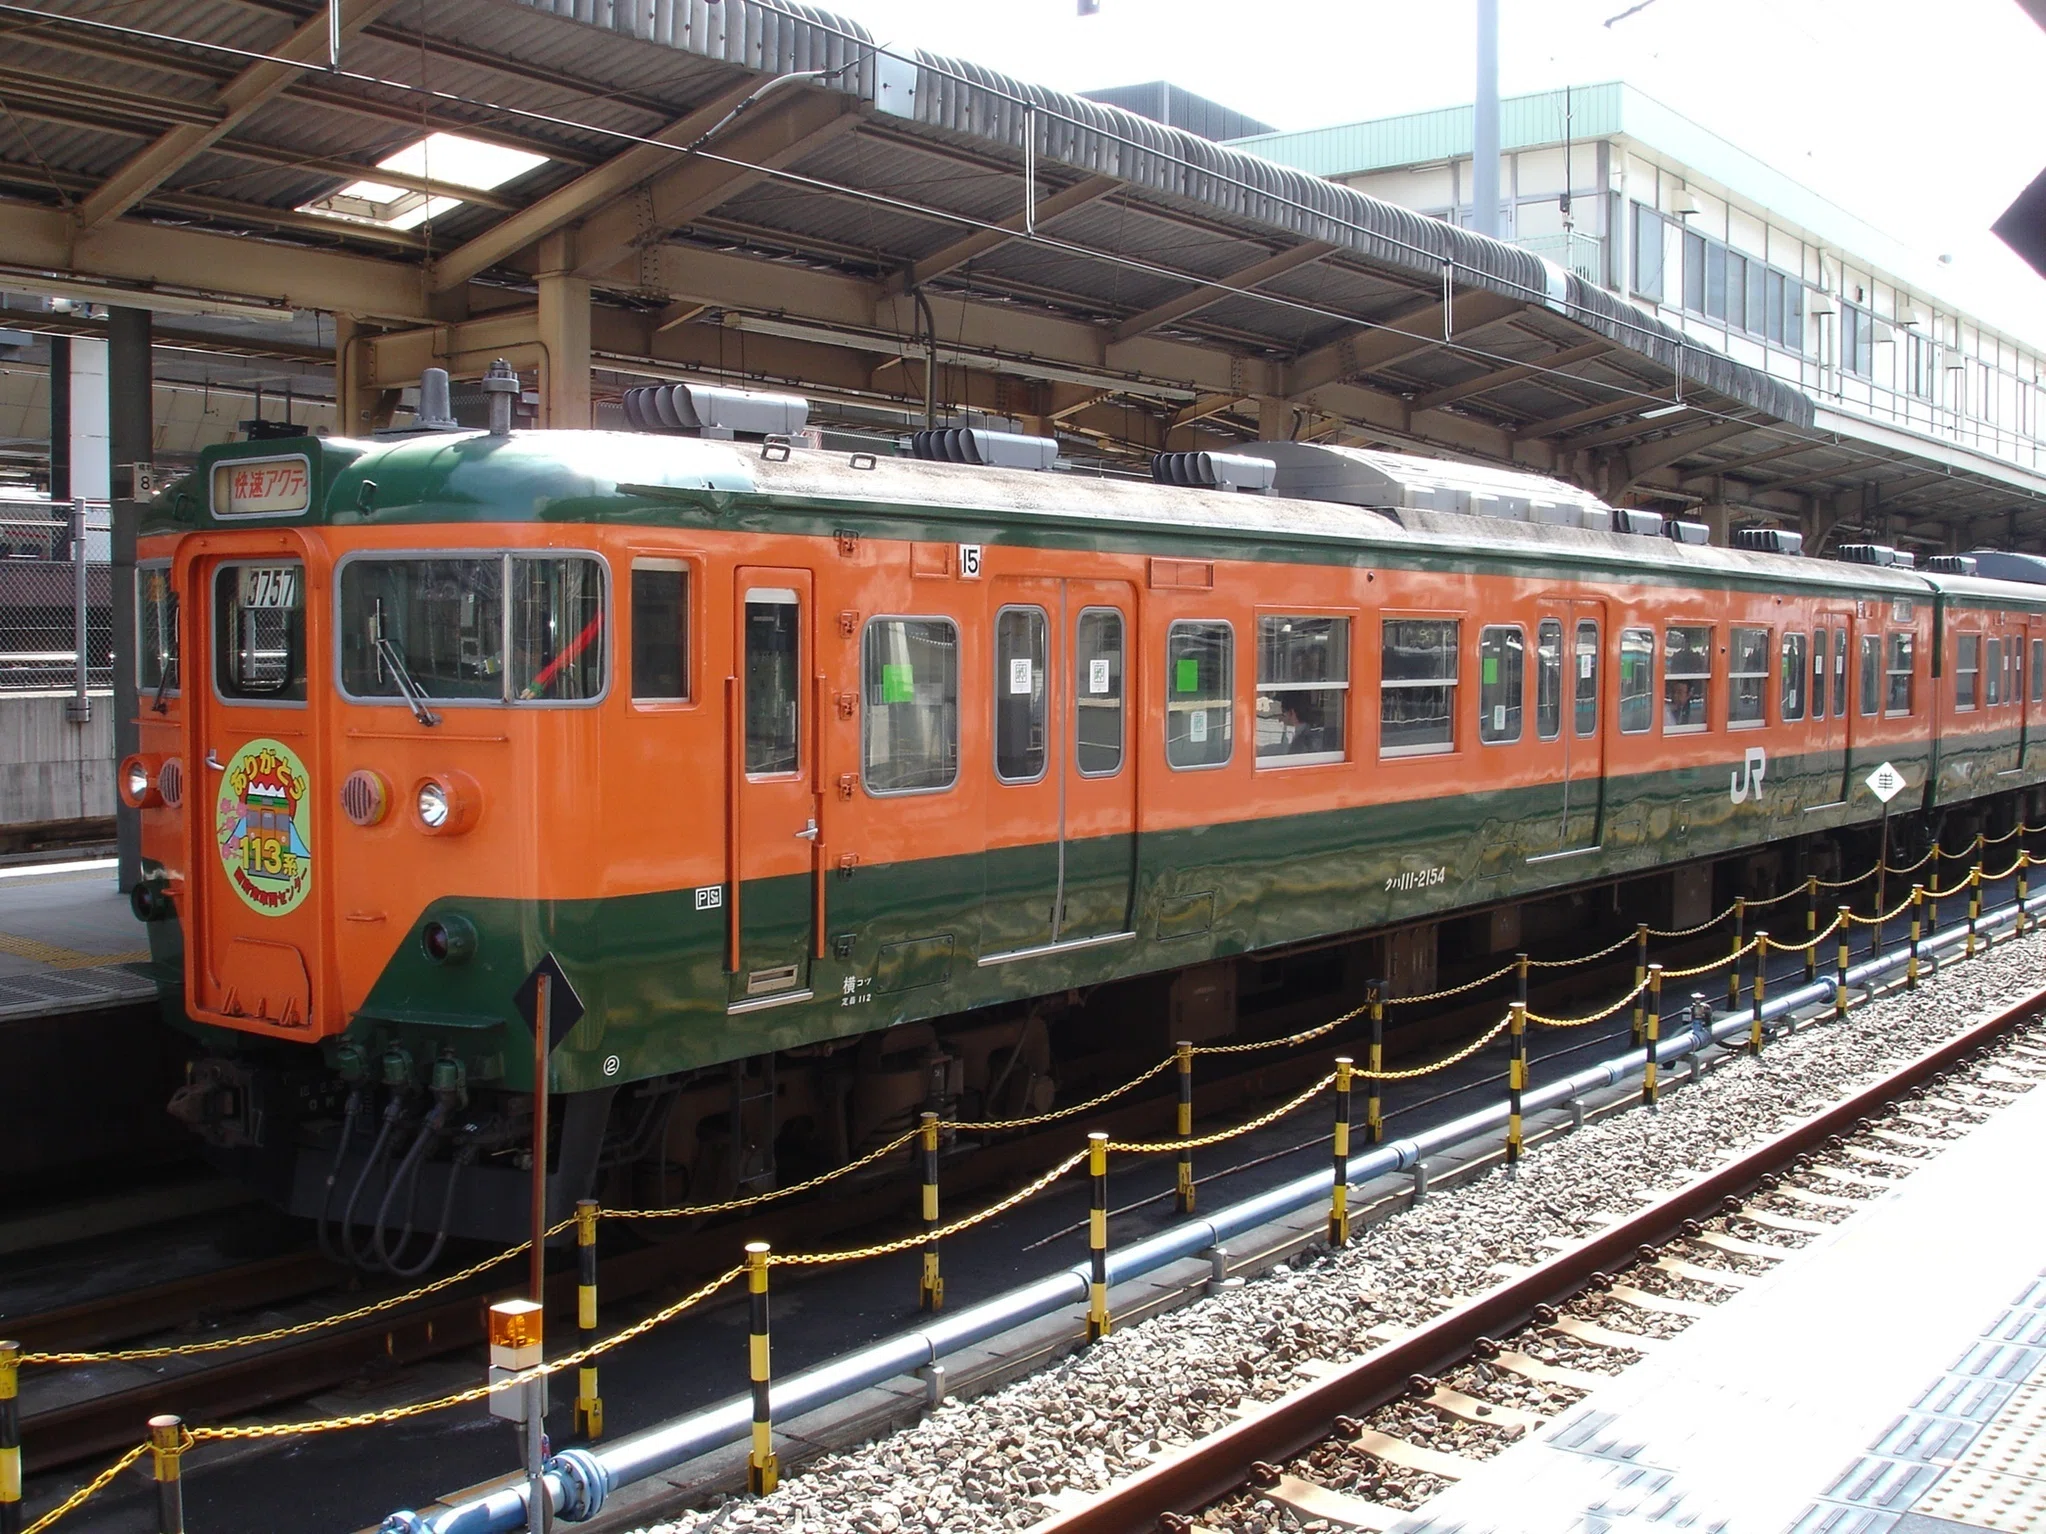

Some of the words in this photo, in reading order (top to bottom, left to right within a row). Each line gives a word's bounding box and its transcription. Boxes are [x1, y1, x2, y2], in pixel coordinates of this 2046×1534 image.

[140, 475, 150, 490] 8
[963, 548, 979, 574] 15
[248, 569, 295, 607] 3757
[230, 748, 307, 801] ありがとう
[1730, 746, 1766, 804] JR
